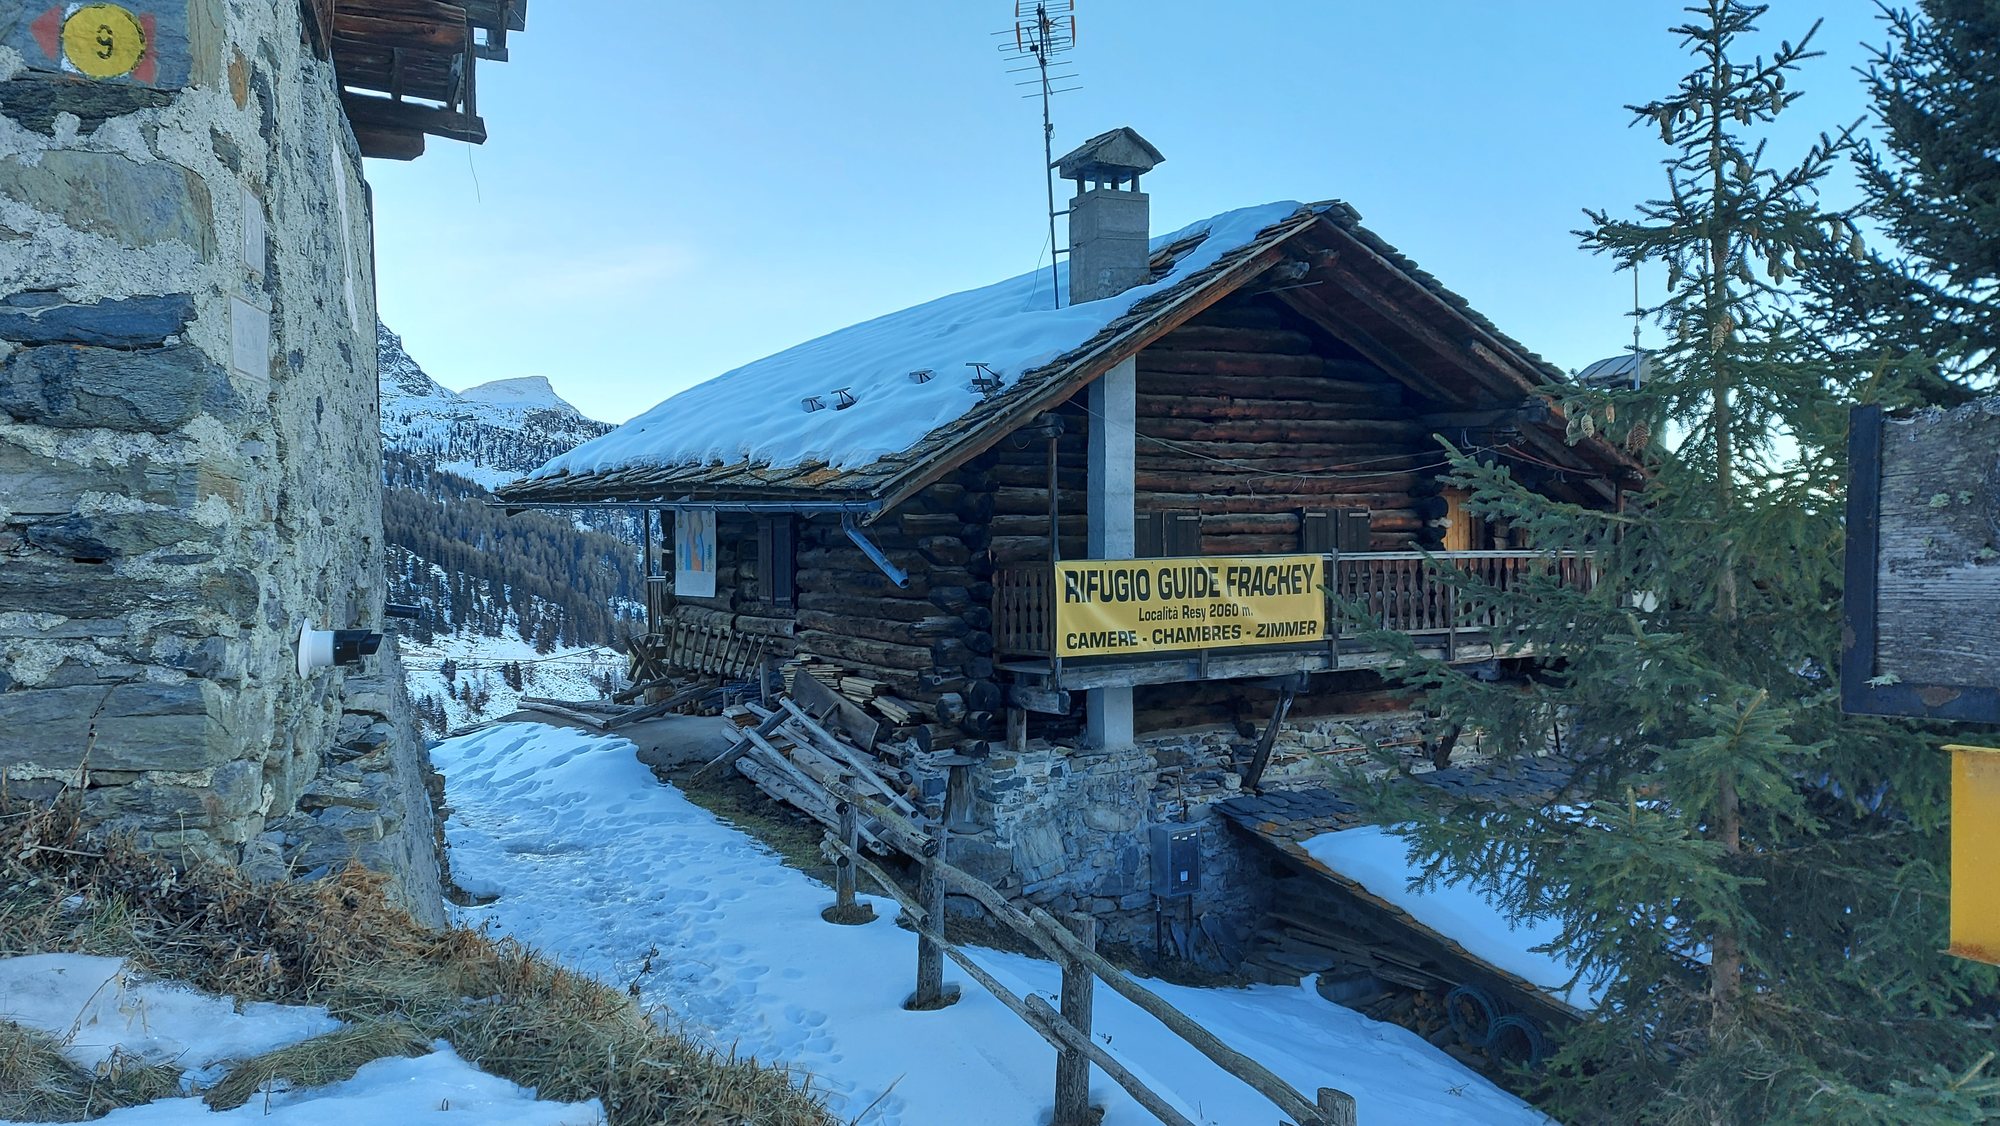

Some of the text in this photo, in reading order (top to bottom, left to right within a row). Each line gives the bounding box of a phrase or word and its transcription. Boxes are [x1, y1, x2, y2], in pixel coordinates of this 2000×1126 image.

[96, 24, 113, 60] 9
[1064, 563, 1316, 603] RIFUGIO GUIDE FRACHEY
[1139, 603, 1253, 622] Località Resy 2060 m.
[1066, 630, 1138, 650] CAMERE
[1152, 624, 1242, 645] CHAMBRES
[1255, 620, 1317, 638] ZIMMER
